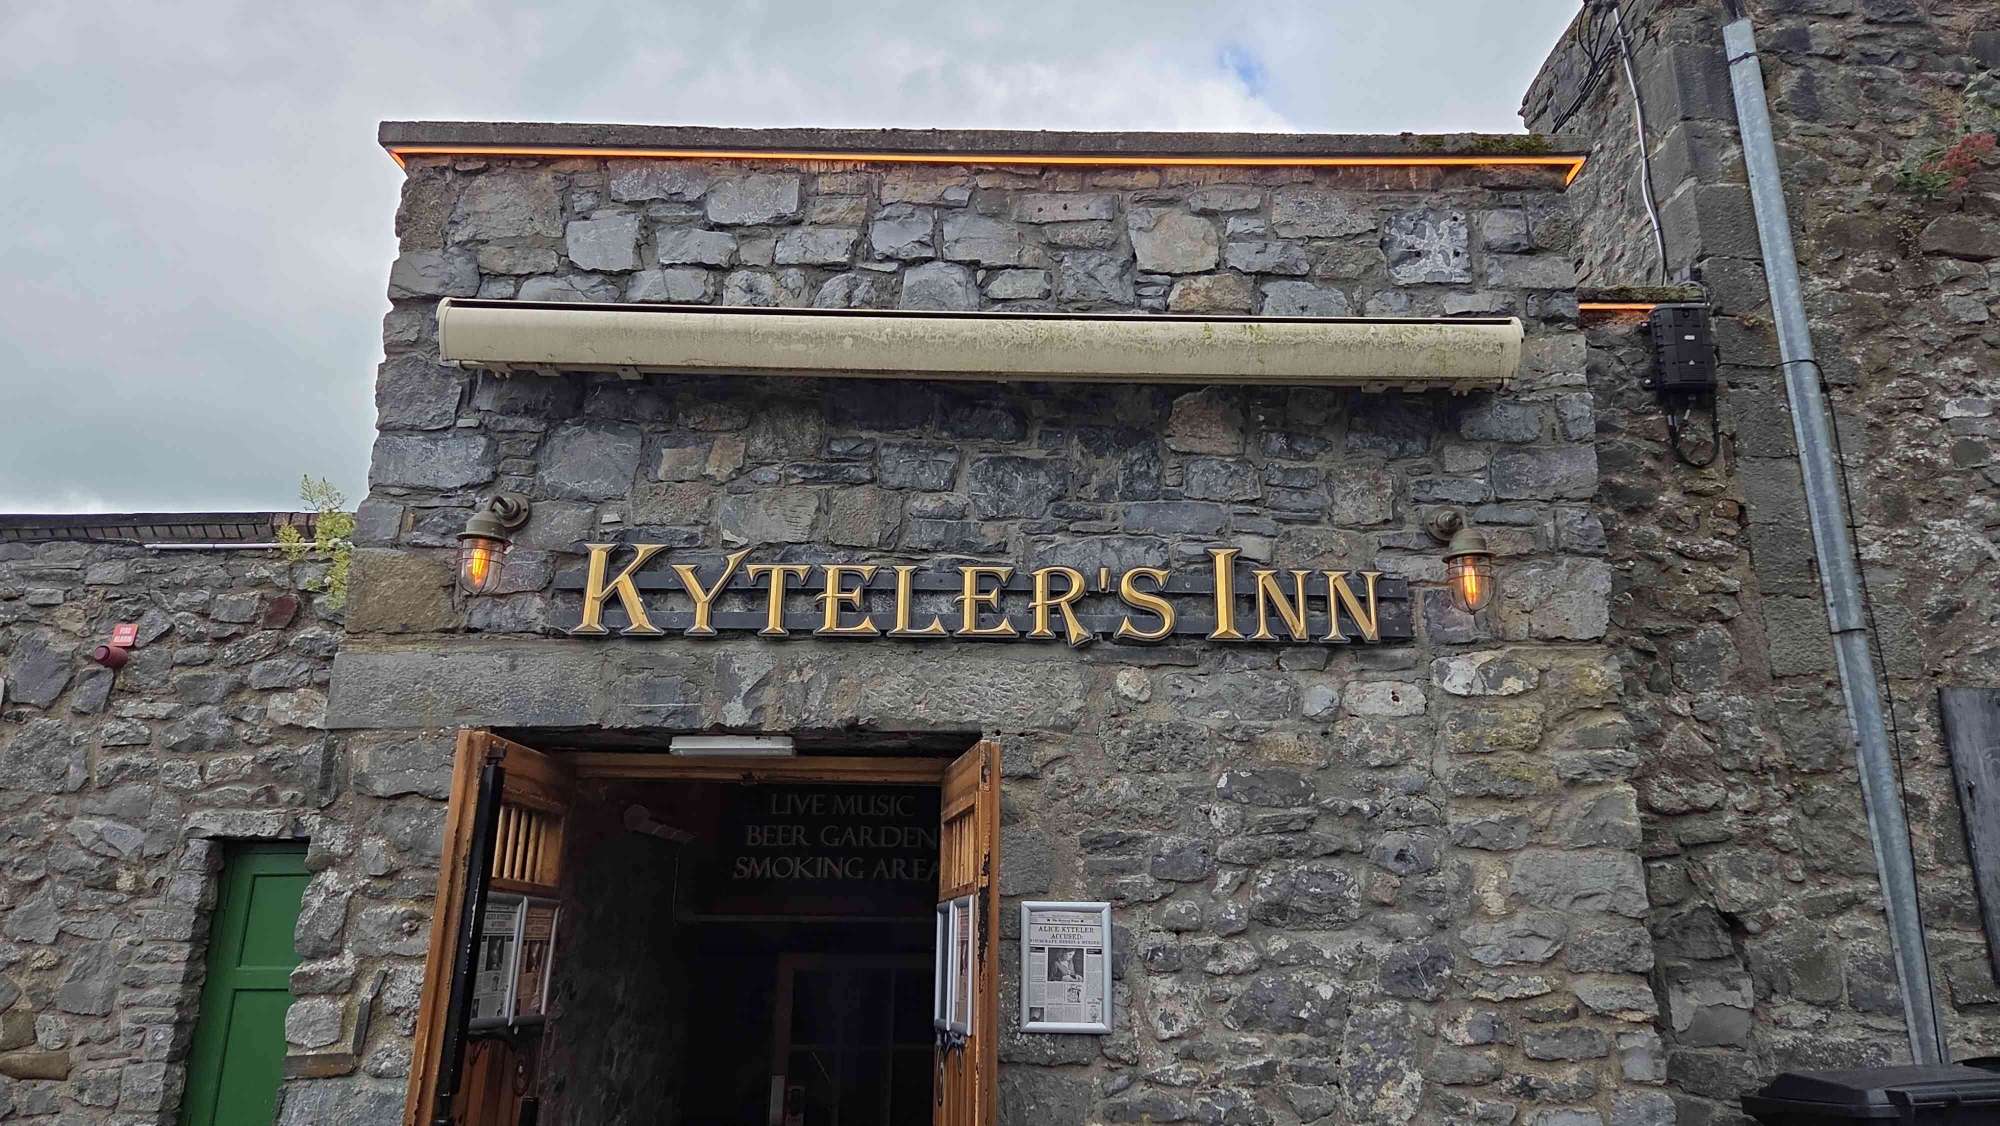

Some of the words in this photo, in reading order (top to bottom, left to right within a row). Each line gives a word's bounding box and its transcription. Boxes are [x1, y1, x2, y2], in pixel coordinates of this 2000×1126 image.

[570, 542, 1177, 646] KYTELER'S
[1206, 547, 1384, 643] INN
[769, 792, 826, 816] LIVE
[832, 793, 916, 817] MUSIC
[745, 824, 812, 847] BEER
[819, 825, 938, 849] GARDEN
[732, 856, 865, 881] SMOKING
